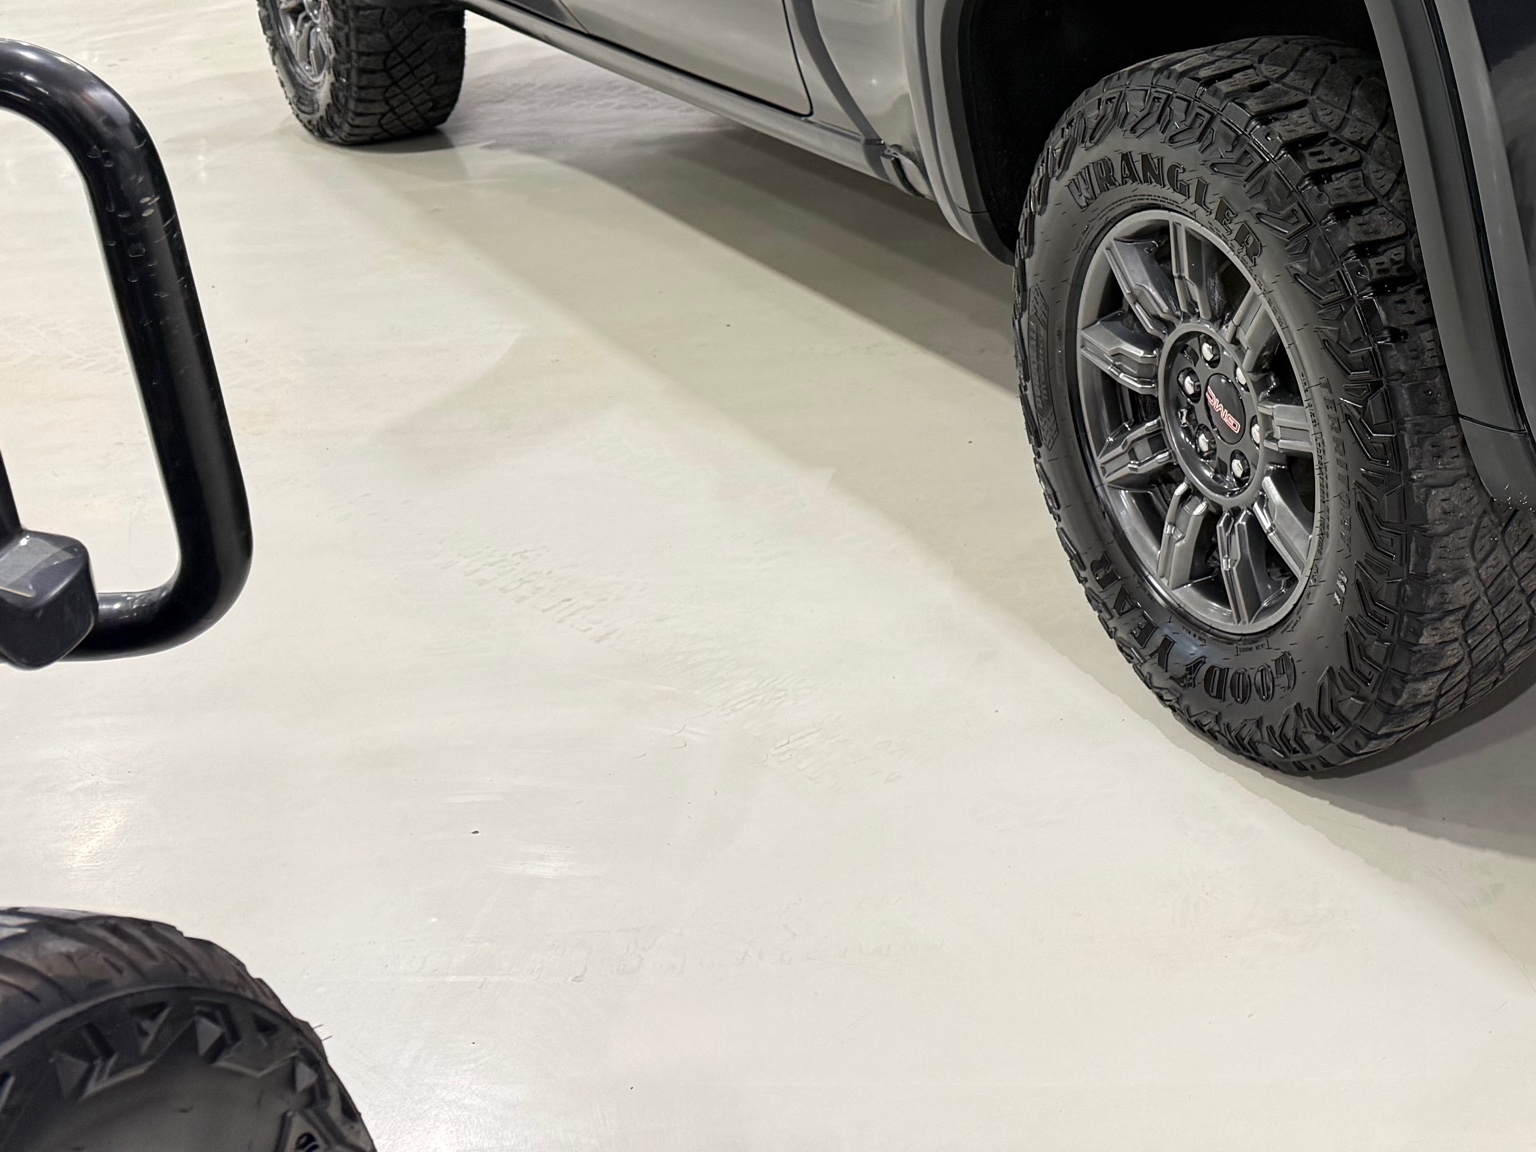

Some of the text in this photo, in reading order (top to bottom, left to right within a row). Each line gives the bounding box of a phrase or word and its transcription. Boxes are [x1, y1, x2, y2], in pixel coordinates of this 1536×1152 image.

[1066, 151, 1263, 268] WRANGLER
[1205, 385, 1241, 434] GMC
[1319, 376, 1351, 548] TERRITORY
[1090, 542, 1297, 705] GOODYEAR
